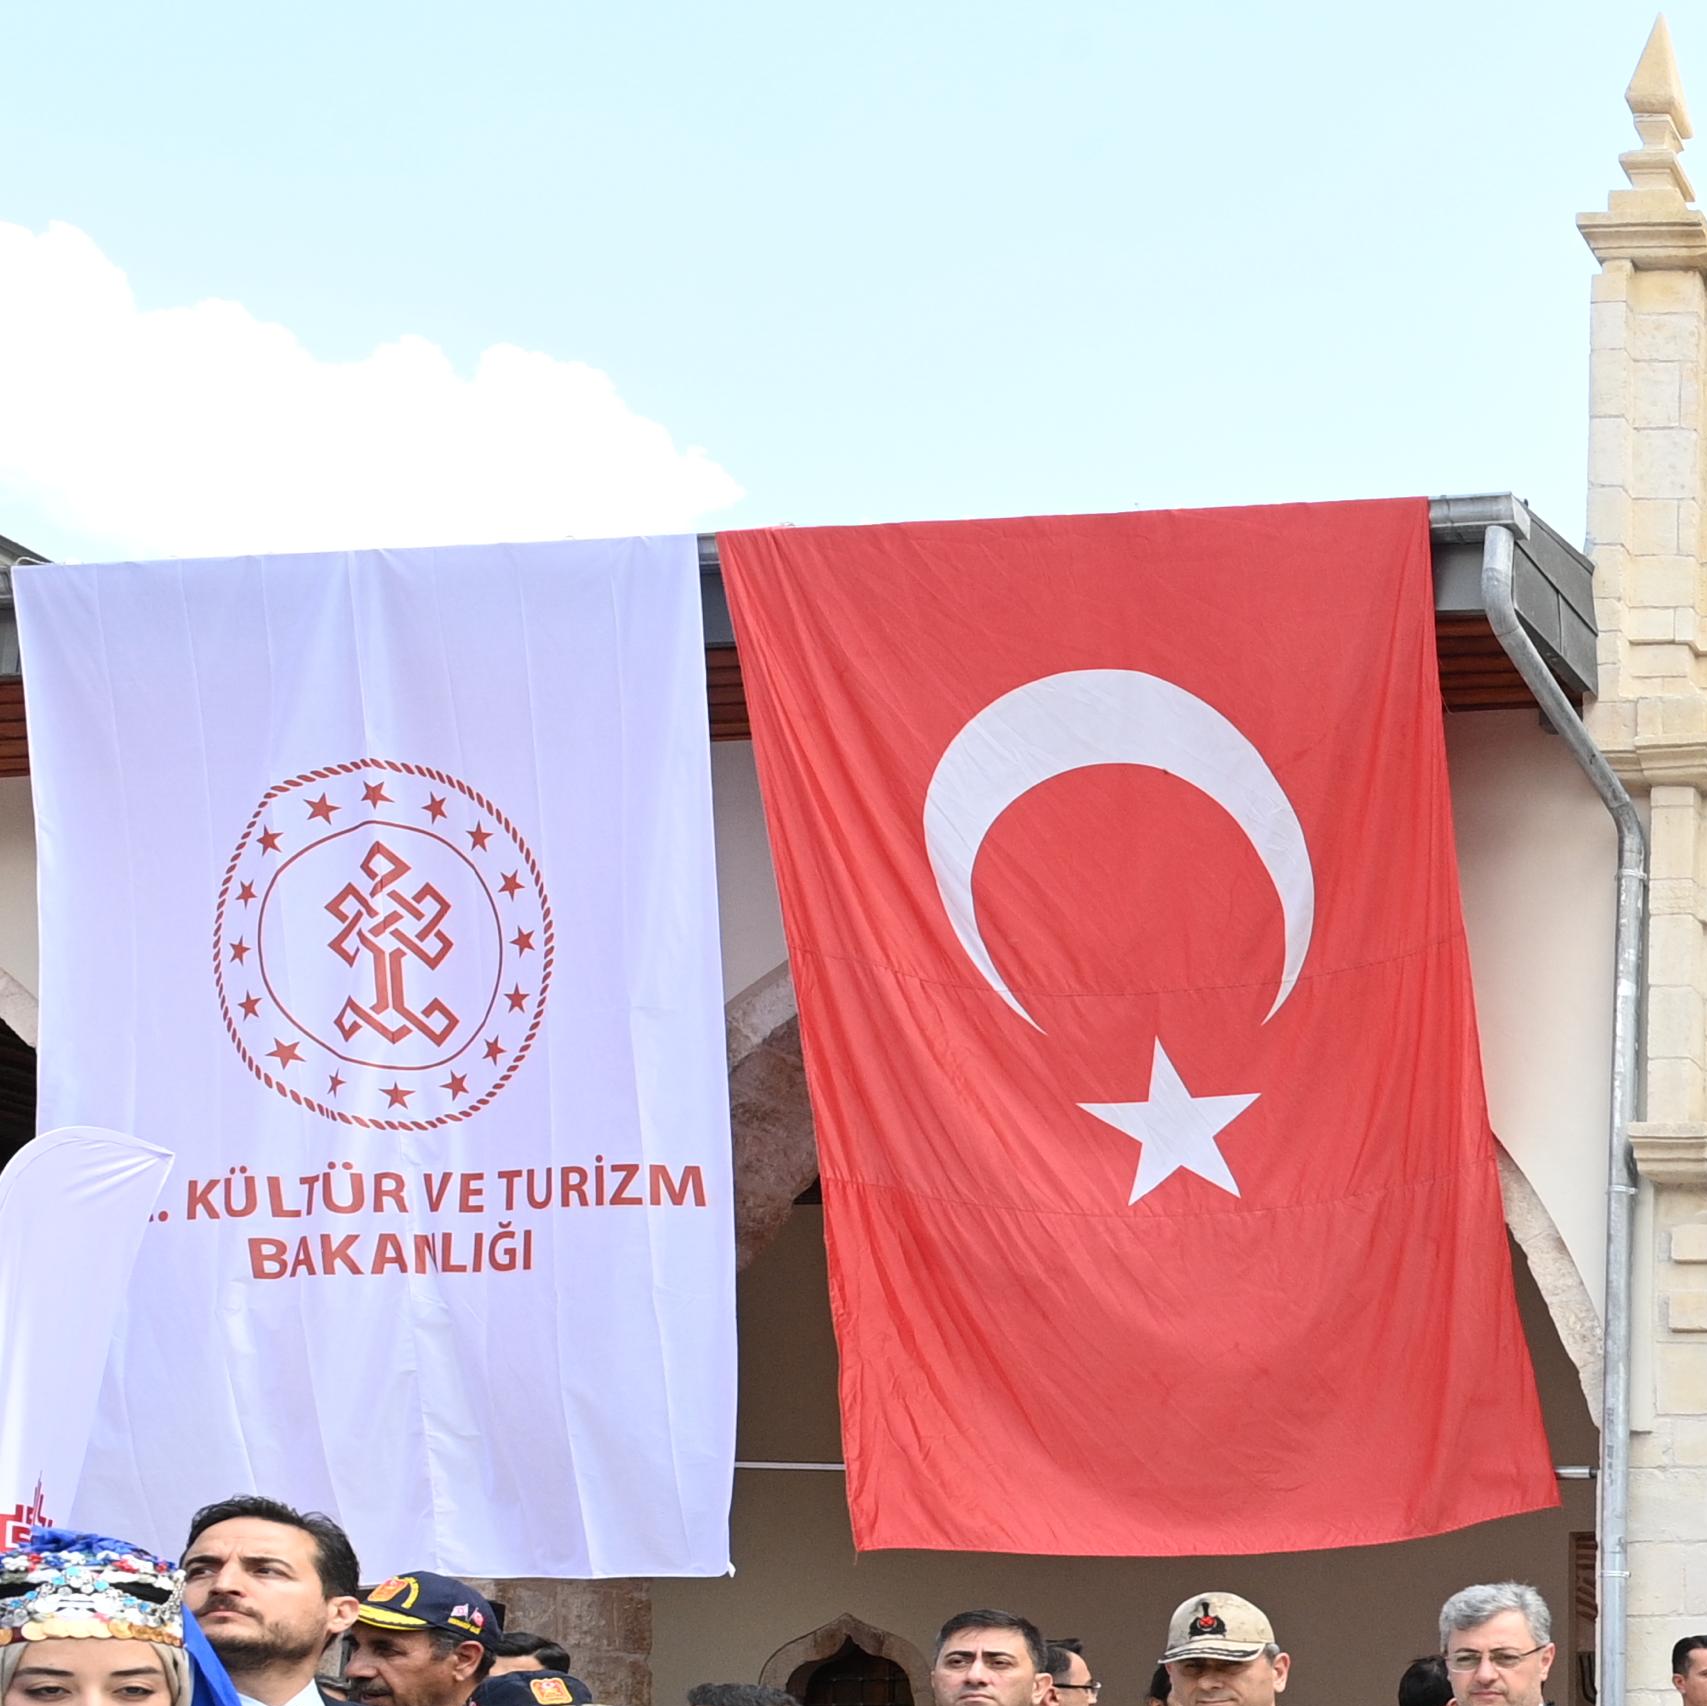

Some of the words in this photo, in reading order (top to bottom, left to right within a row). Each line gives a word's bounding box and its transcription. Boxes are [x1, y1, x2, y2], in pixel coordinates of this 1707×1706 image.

[187, 1161, 409, 1220] KÜLTÜR
[423, 1172, 485, 1214] VE
[497, 1154, 707, 1211] TURİZM
[248, 1221, 532, 1280] BAKANLIĞI
